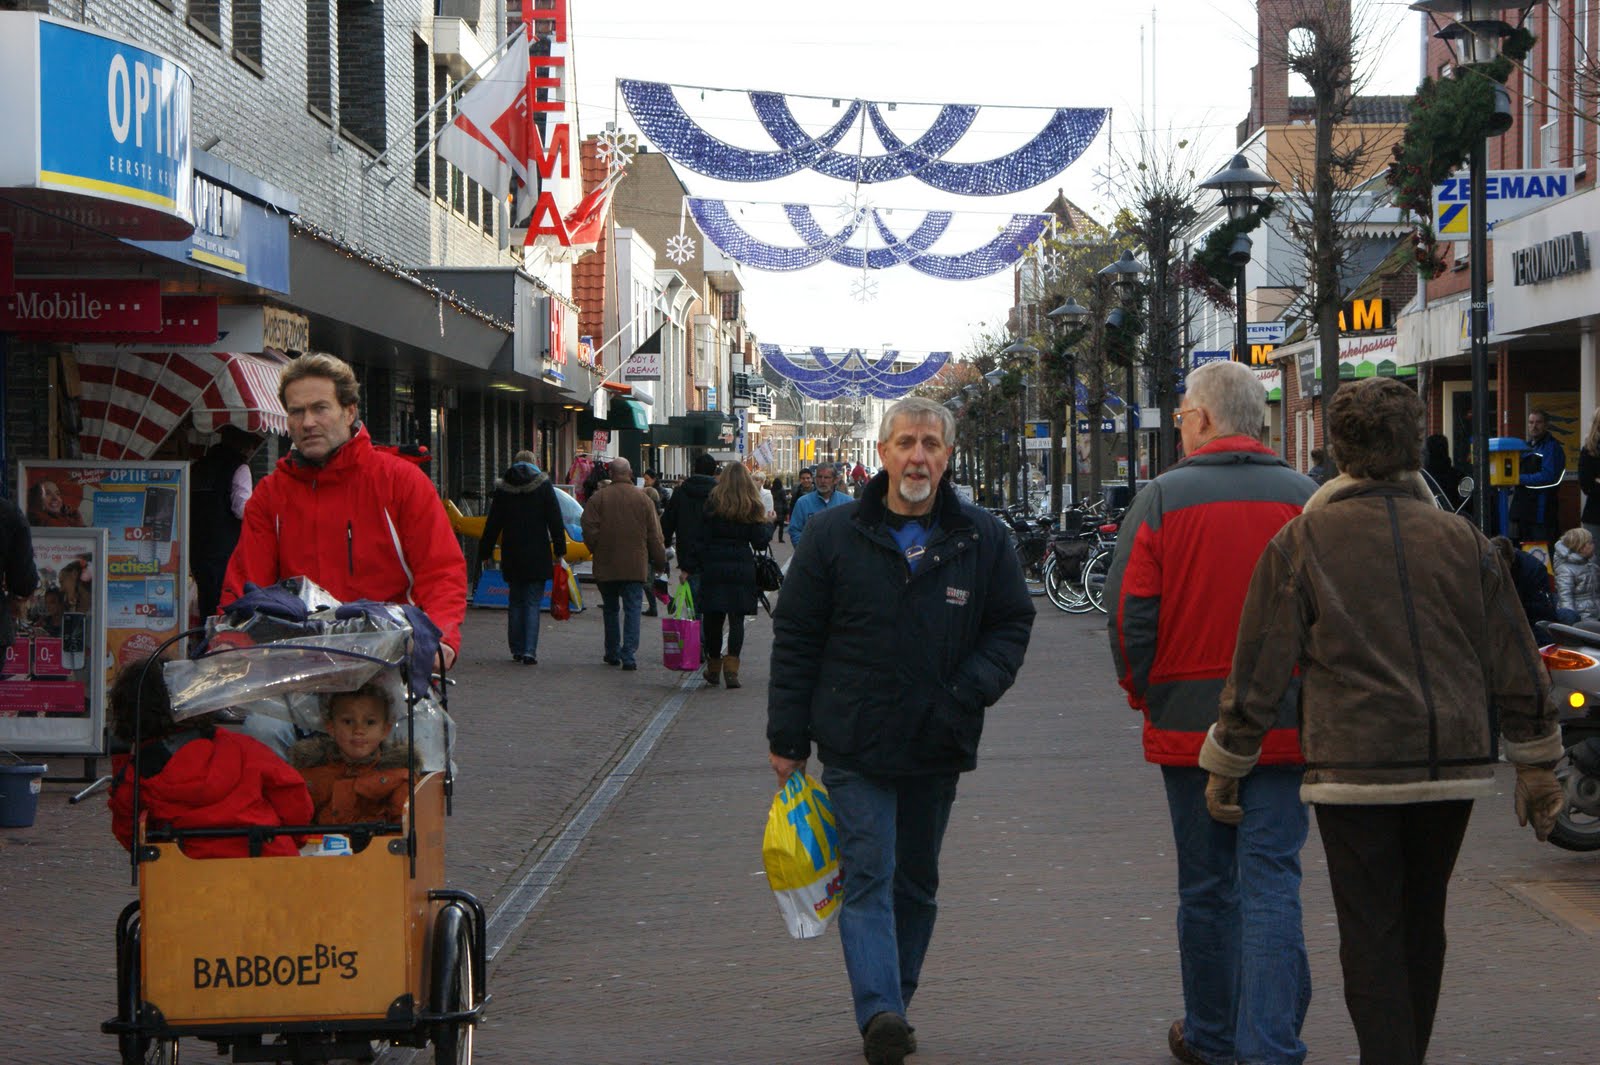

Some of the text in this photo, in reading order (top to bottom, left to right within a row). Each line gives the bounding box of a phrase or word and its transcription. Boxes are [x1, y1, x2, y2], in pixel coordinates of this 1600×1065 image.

[522, 0, 572, 246] HEMA
[109, 155, 152, 180] EERSTE
[1438, 175, 1567, 201] ZEEMAN
[1512, 231, 1577, 286] VERO MODA
[16, 292, 102, 320] Mobile
[1247, 325, 1284, 333] TERNET
[110, 469, 147, 481] OPTIE
[109, 558, 160, 573] acties!
[193, 944, 358, 989] BABBOE Big
